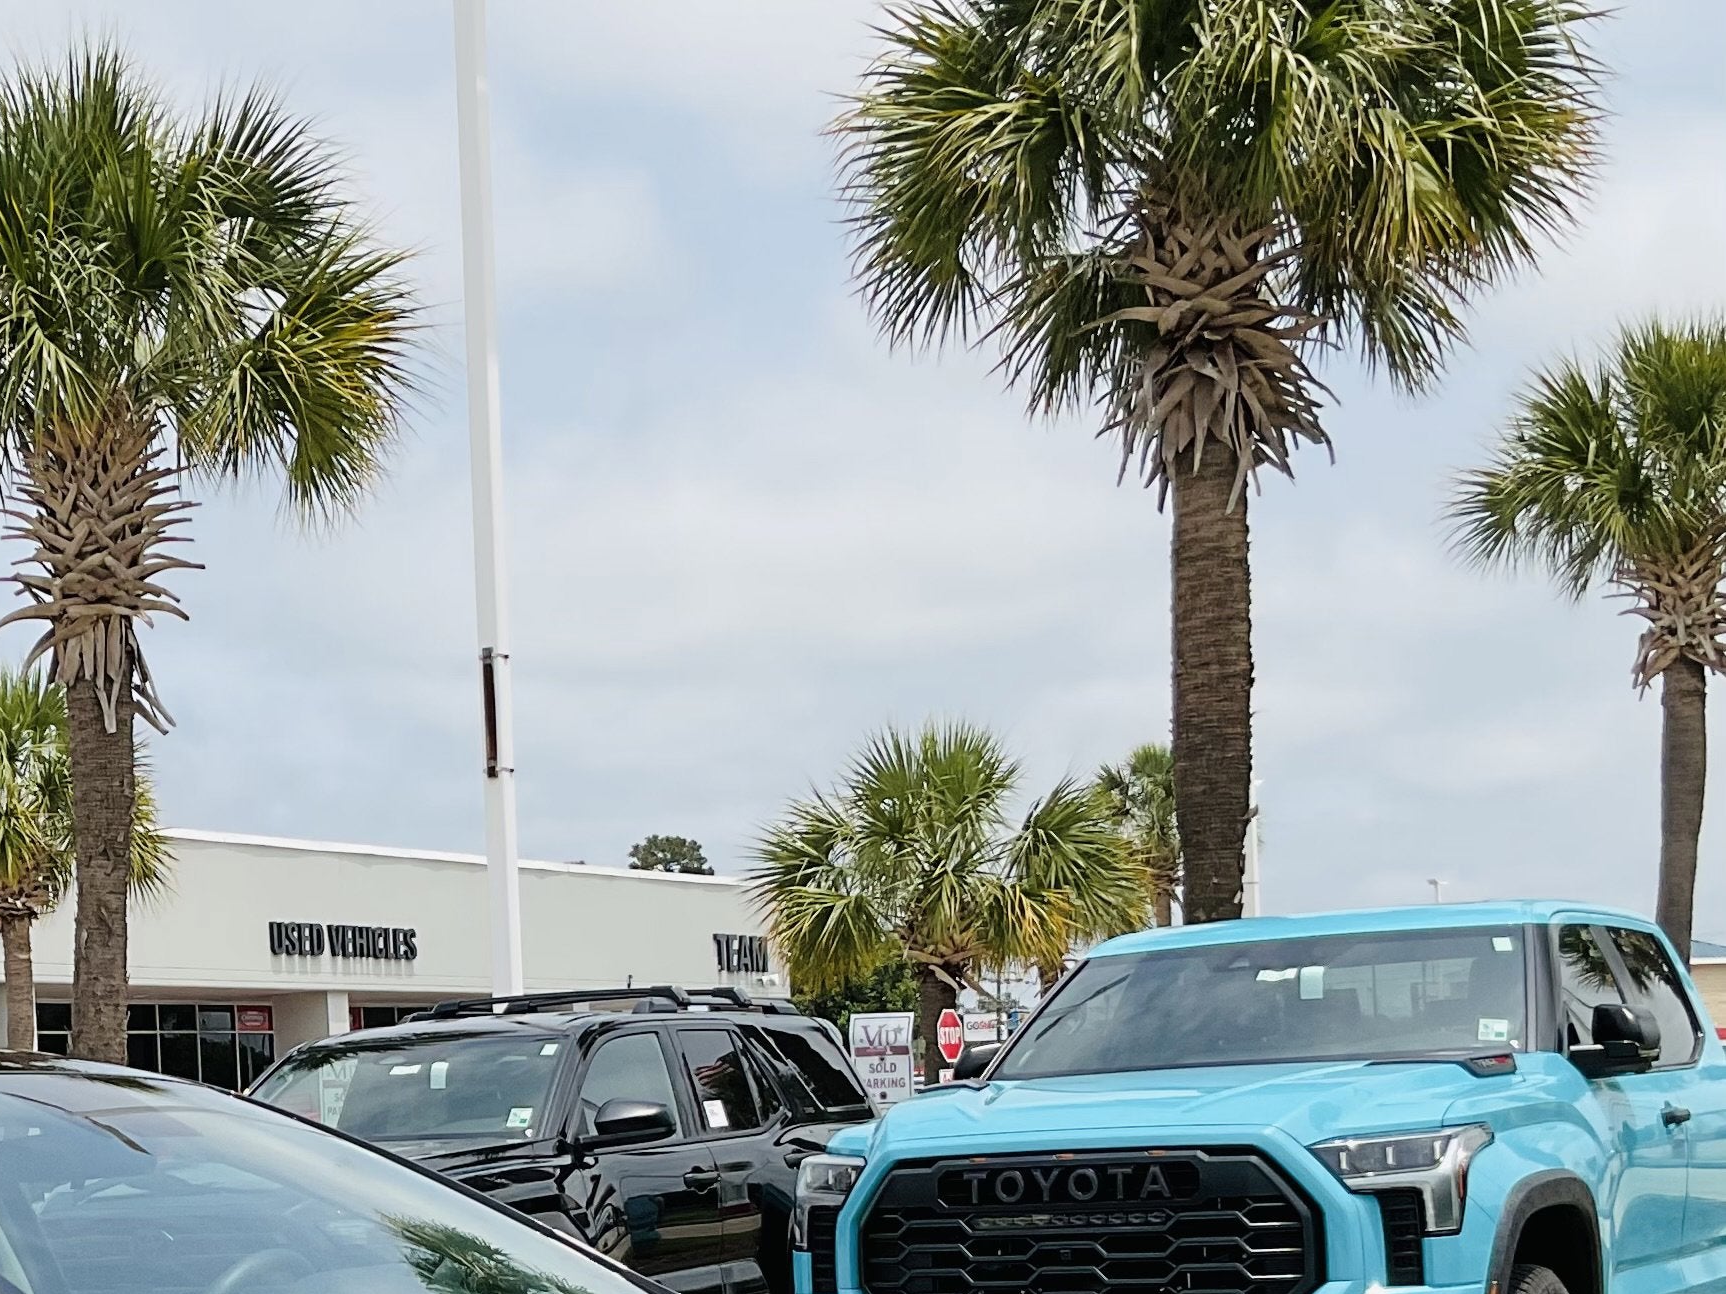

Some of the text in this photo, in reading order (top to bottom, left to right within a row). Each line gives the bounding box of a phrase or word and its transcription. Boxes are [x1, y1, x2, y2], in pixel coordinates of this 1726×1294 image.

[268, 921, 418, 960] USED VEHICLES
[712, 933, 769, 973] TEAM
[940, 1027, 961, 1044] STOP
[869, 1062, 897, 1074] SOLD
[863, 1077, 906, 1089] ARKING
[962, 1164, 1172, 1203] TOYOTA
